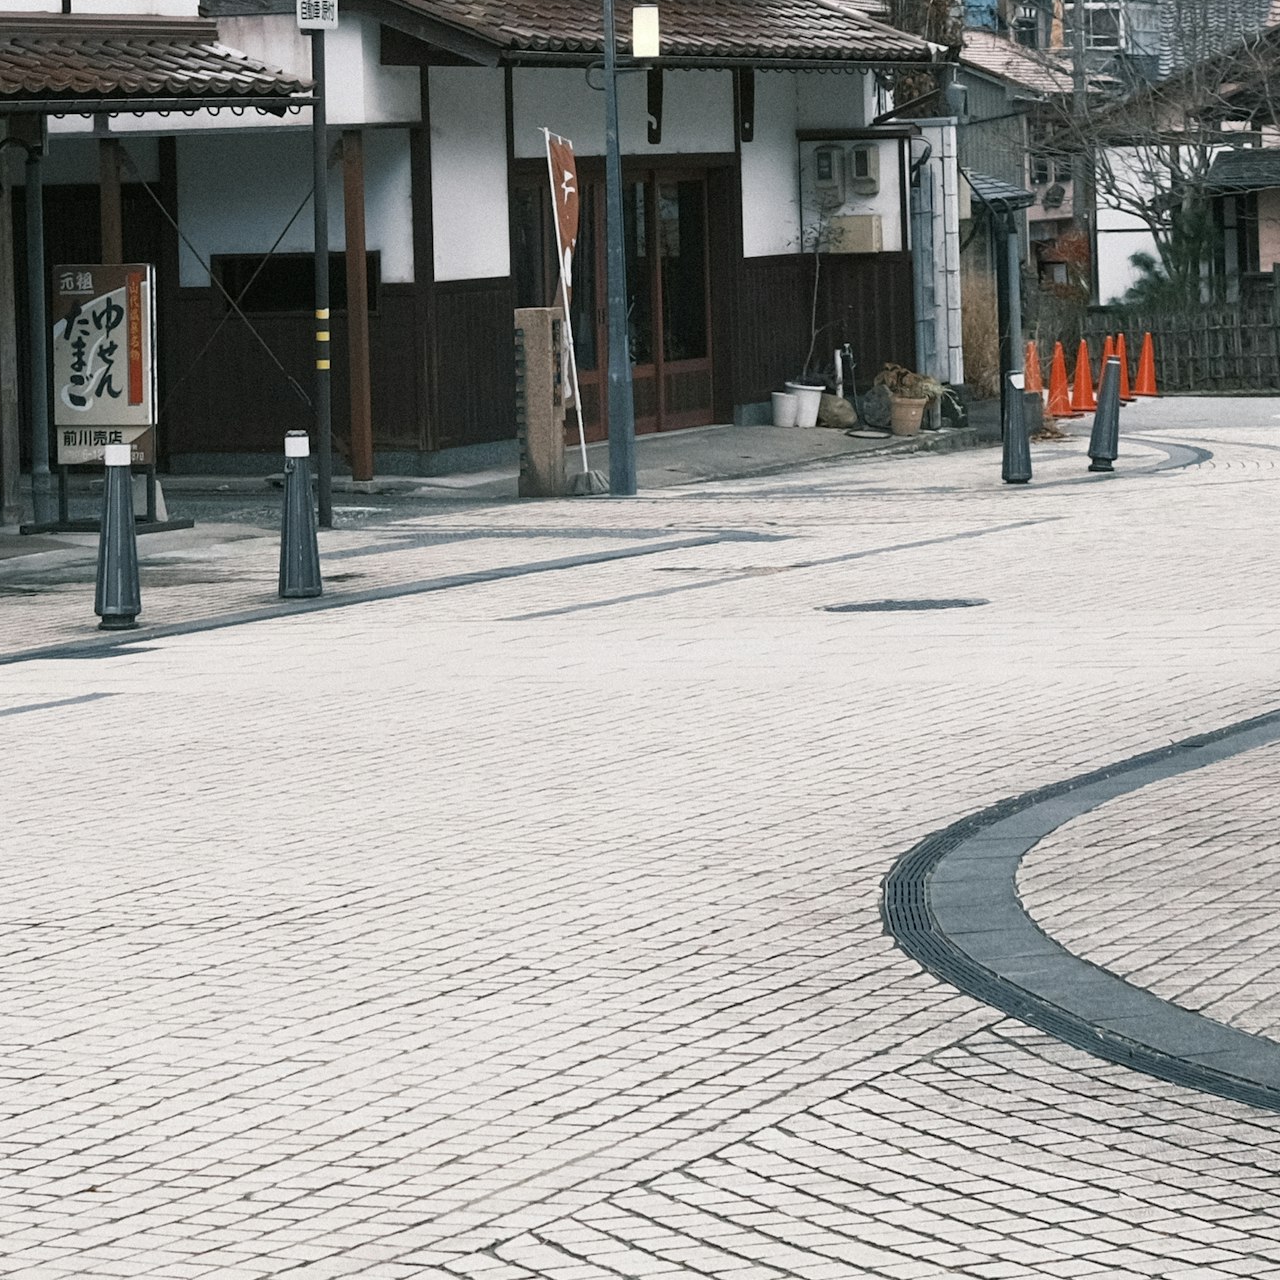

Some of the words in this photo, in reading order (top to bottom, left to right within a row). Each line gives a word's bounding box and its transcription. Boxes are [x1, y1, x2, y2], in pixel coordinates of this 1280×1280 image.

[59, 271, 93, 291] 元祖
[64, 303, 94, 407] たまご
[92, 296, 125, 399] ゆせん
[63, 430, 122, 447] 前川売店
